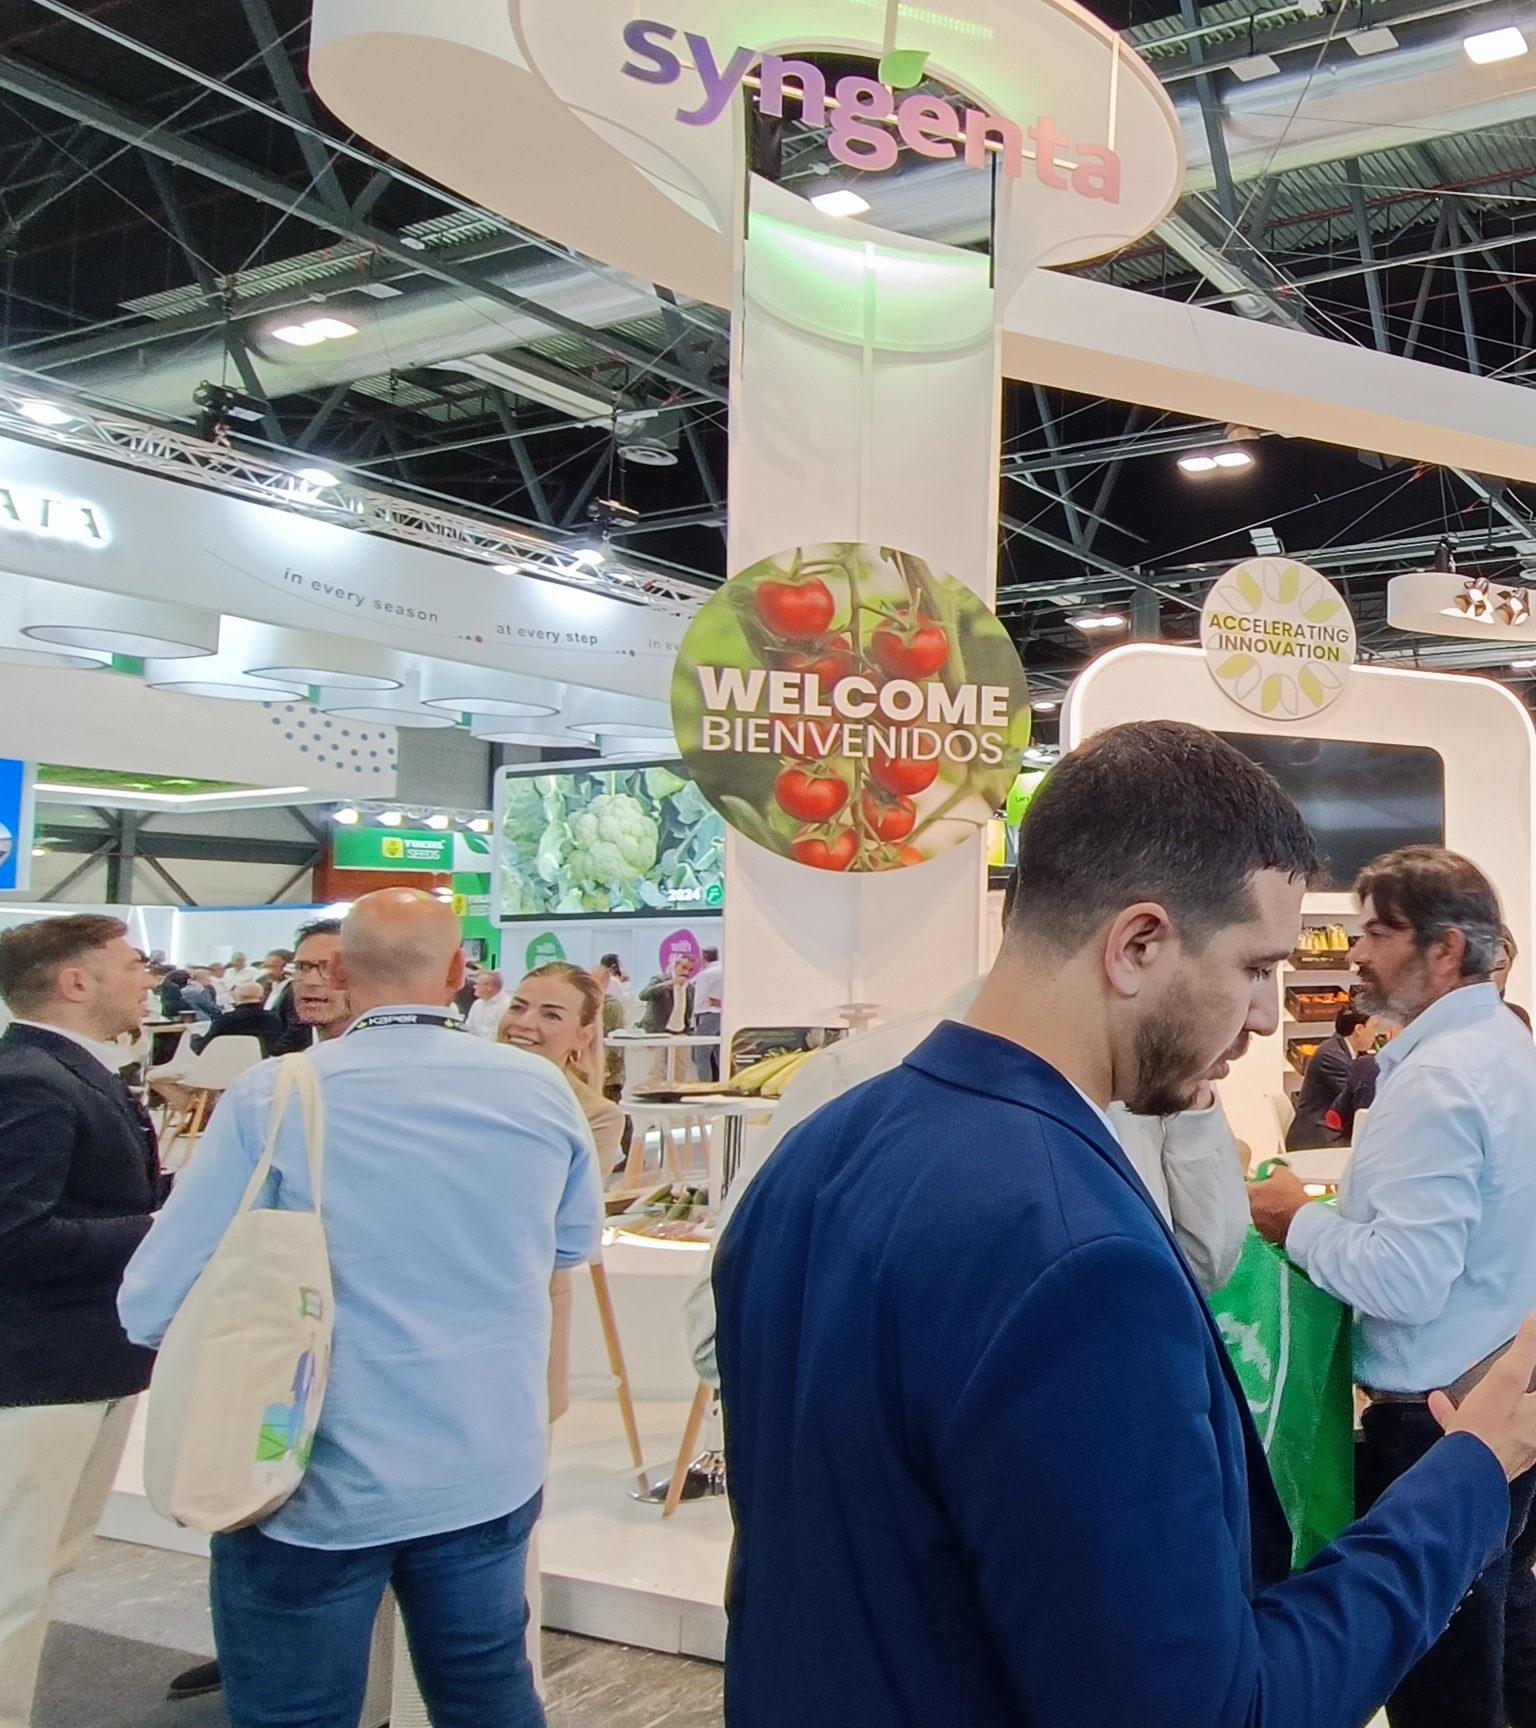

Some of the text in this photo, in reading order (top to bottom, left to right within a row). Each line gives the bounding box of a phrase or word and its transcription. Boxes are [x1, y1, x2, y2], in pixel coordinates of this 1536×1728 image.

[620, 18, 1121, 204] syngenta
[284, 568, 439, 623] in every season
[497, 624, 598, 647] at every step
[1209, 613, 1350, 644] ACCELERATING
[1218, 634, 1340, 662] INNOVATION
[697, 665, 1011, 728] WELCOME
[700, 715, 1004, 765] BIENVENIDOS
[406, 848, 441, 861] SEEDS
[667, 888, 701, 902] 2024
